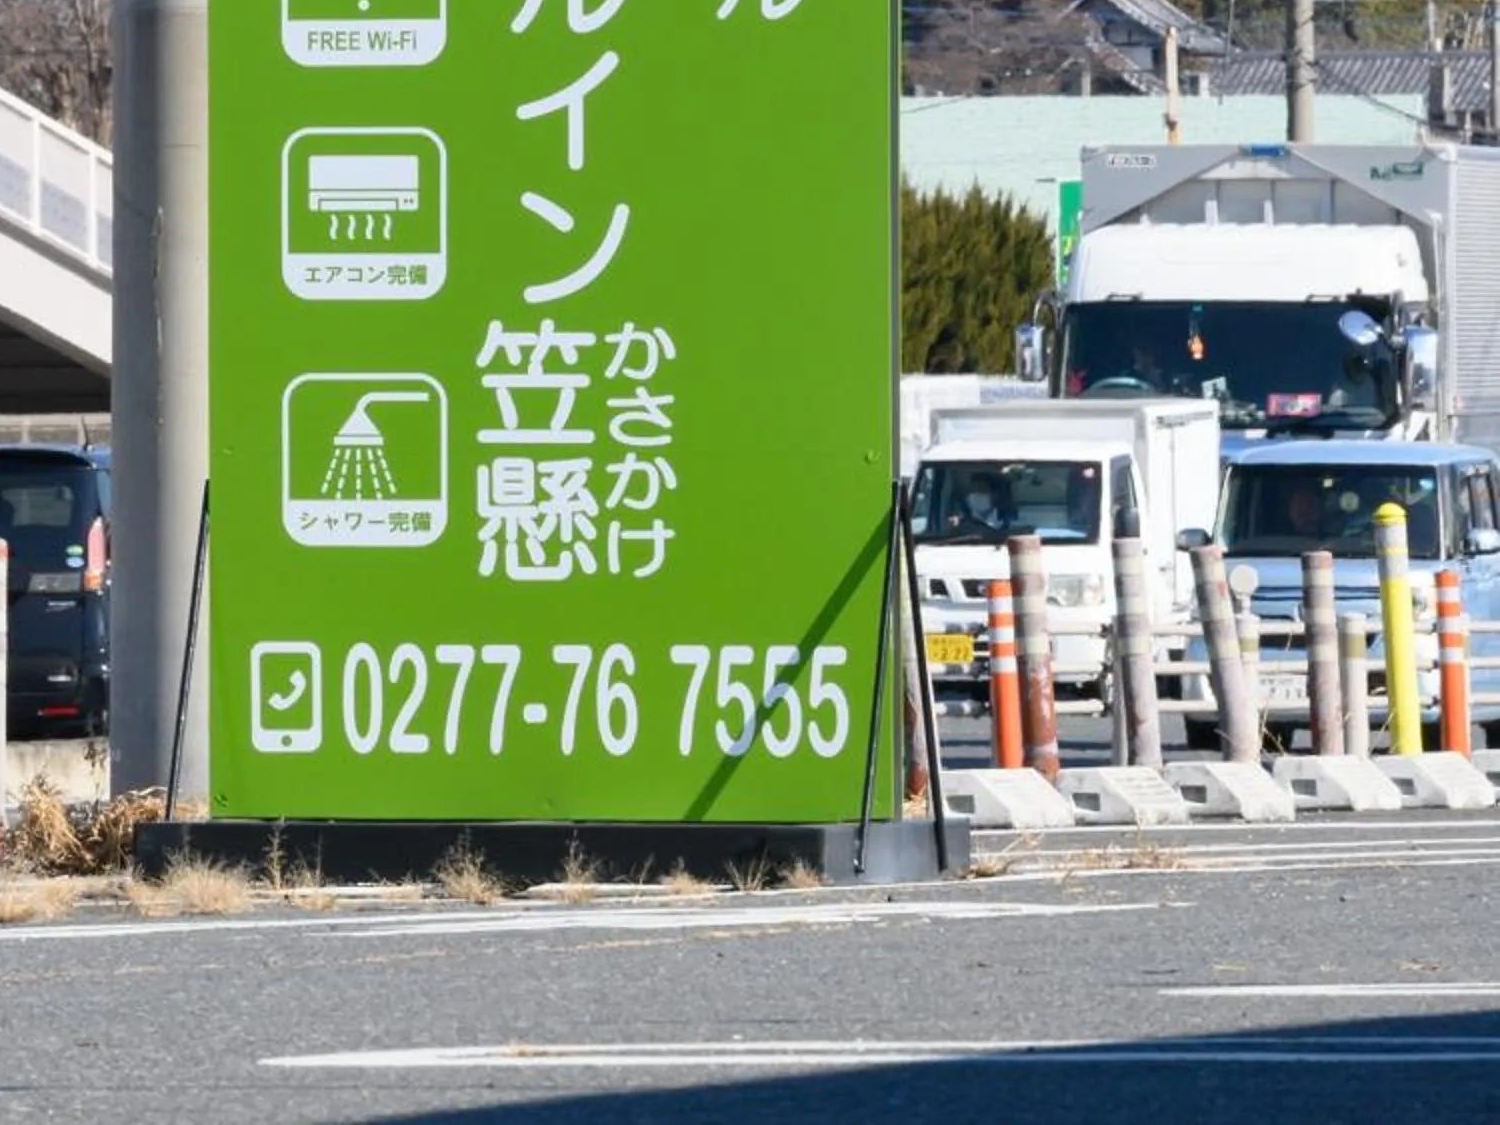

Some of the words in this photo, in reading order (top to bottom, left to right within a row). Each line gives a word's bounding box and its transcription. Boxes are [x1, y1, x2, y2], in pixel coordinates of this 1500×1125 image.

[307, 31, 361, 51] FREE
[366, 31, 417, 51] Wi-Fi
[303, 263, 428, 286] エアコン完備
[604, 322, 677, 577] かさかけ
[299, 510, 432, 533] シャワー完備
[342, 642, 638, 756] 0277-76
[670, 645, 849, 758] 7555
